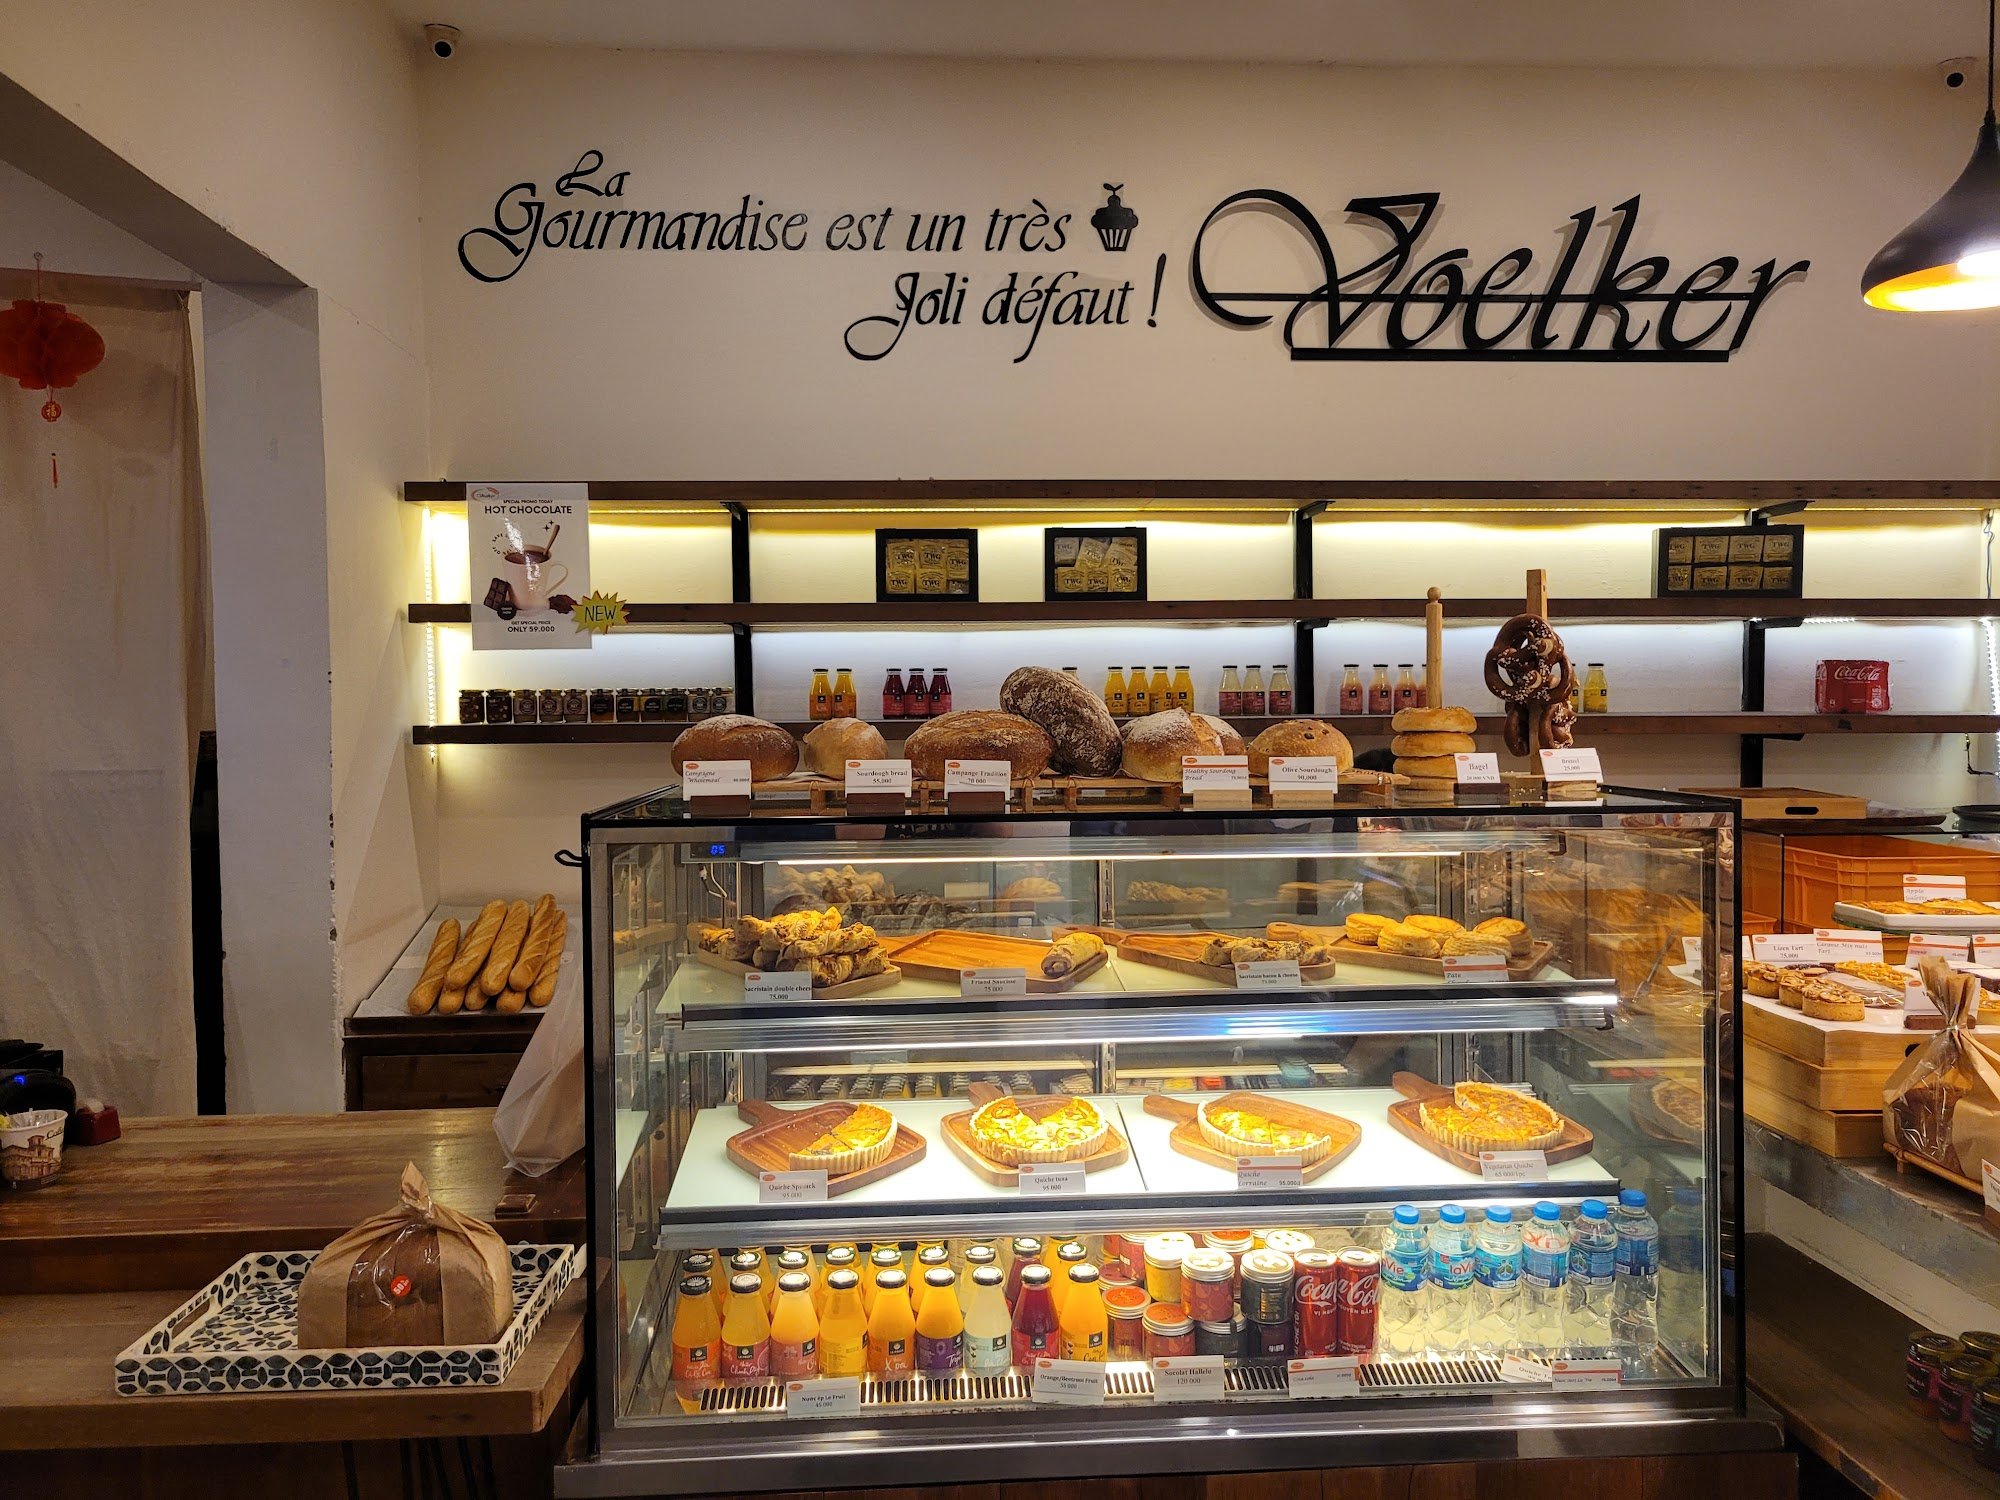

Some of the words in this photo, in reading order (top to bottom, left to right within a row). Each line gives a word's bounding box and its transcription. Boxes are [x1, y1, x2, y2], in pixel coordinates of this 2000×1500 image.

[556, 150, 630, 197] La
[458, 182, 808, 283] Gourmandise
[826, 204, 894, 252] est
[906, 213, 963, 253] un
[984, 199, 1068, 253] très
[1193, 189, 1810, 355] Voelker
[845, 271, 967, 361] Joli
[983, 271, 1134, 363] défaut
[484, 505, 507, 514] HOT
[508, 505, 573, 514] CHOCOLATE
[925, 552, 941, 560] TWG
[584, 605, 616, 623] NEW
[856, 770, 890, 778] Sourdough
[1469, 763, 1489, 771] Bagel
